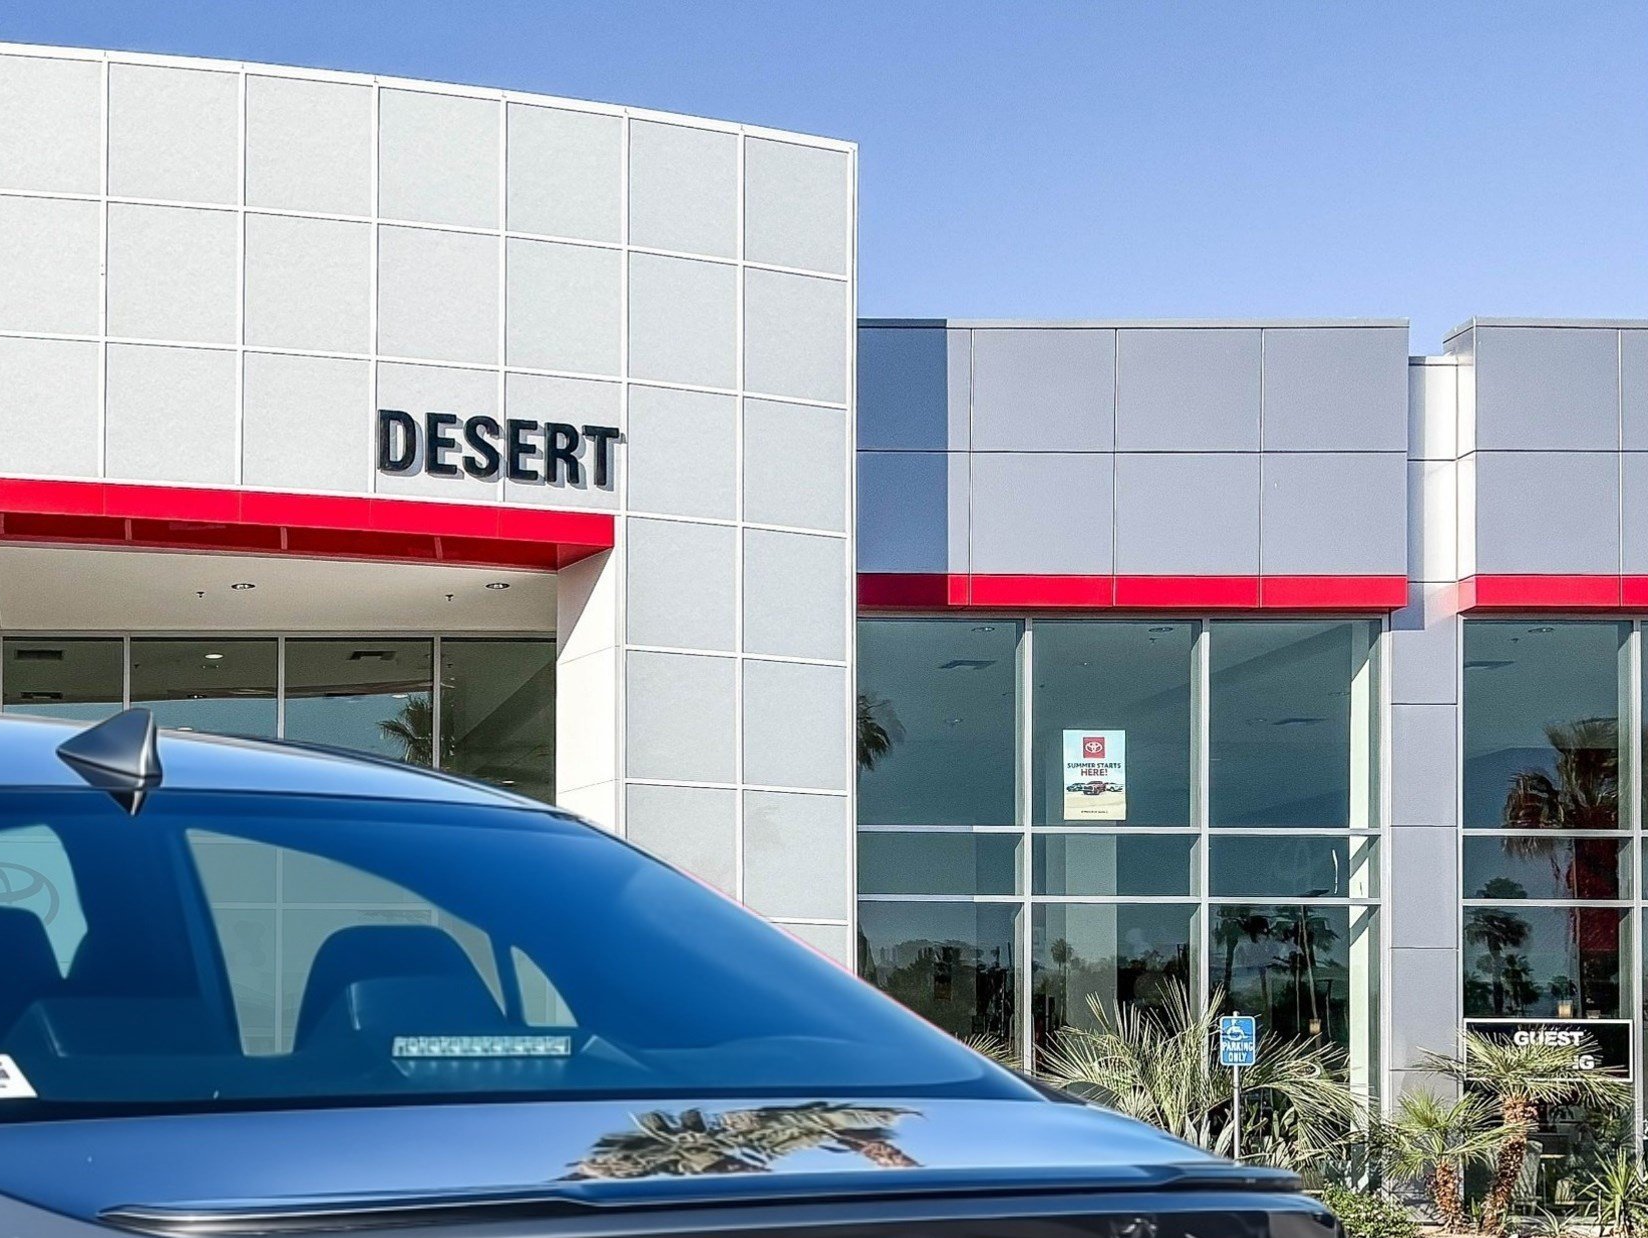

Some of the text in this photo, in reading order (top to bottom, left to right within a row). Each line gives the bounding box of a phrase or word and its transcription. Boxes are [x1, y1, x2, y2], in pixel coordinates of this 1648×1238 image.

[377, 409, 620, 486] DESERT
[1513, 1030, 1584, 1046] GUEST
[1222, 1041, 1254, 1052] PARKING
[1228, 1052, 1247, 1062] ONLY
